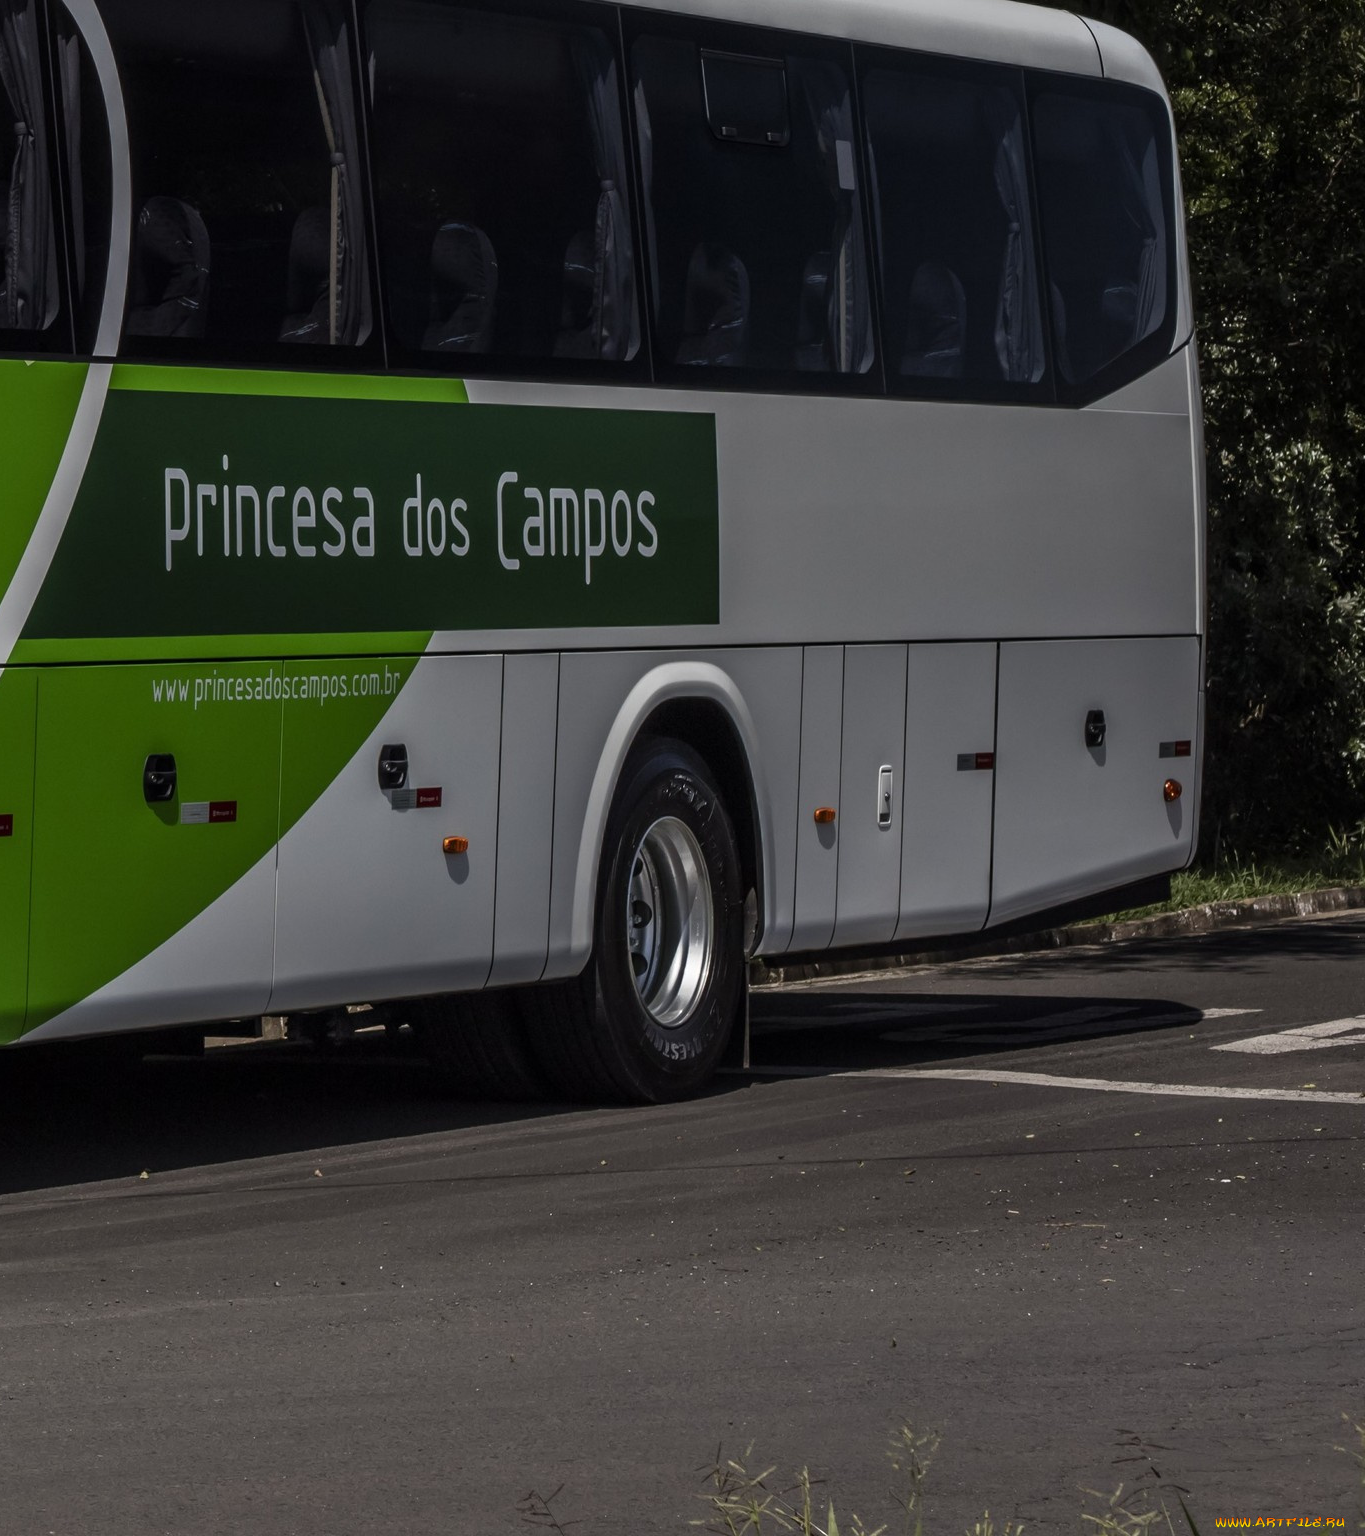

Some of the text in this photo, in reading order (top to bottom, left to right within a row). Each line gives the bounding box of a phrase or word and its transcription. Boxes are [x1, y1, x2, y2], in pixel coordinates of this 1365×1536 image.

[164, 454, 659, 585] Princesa dos Campos
